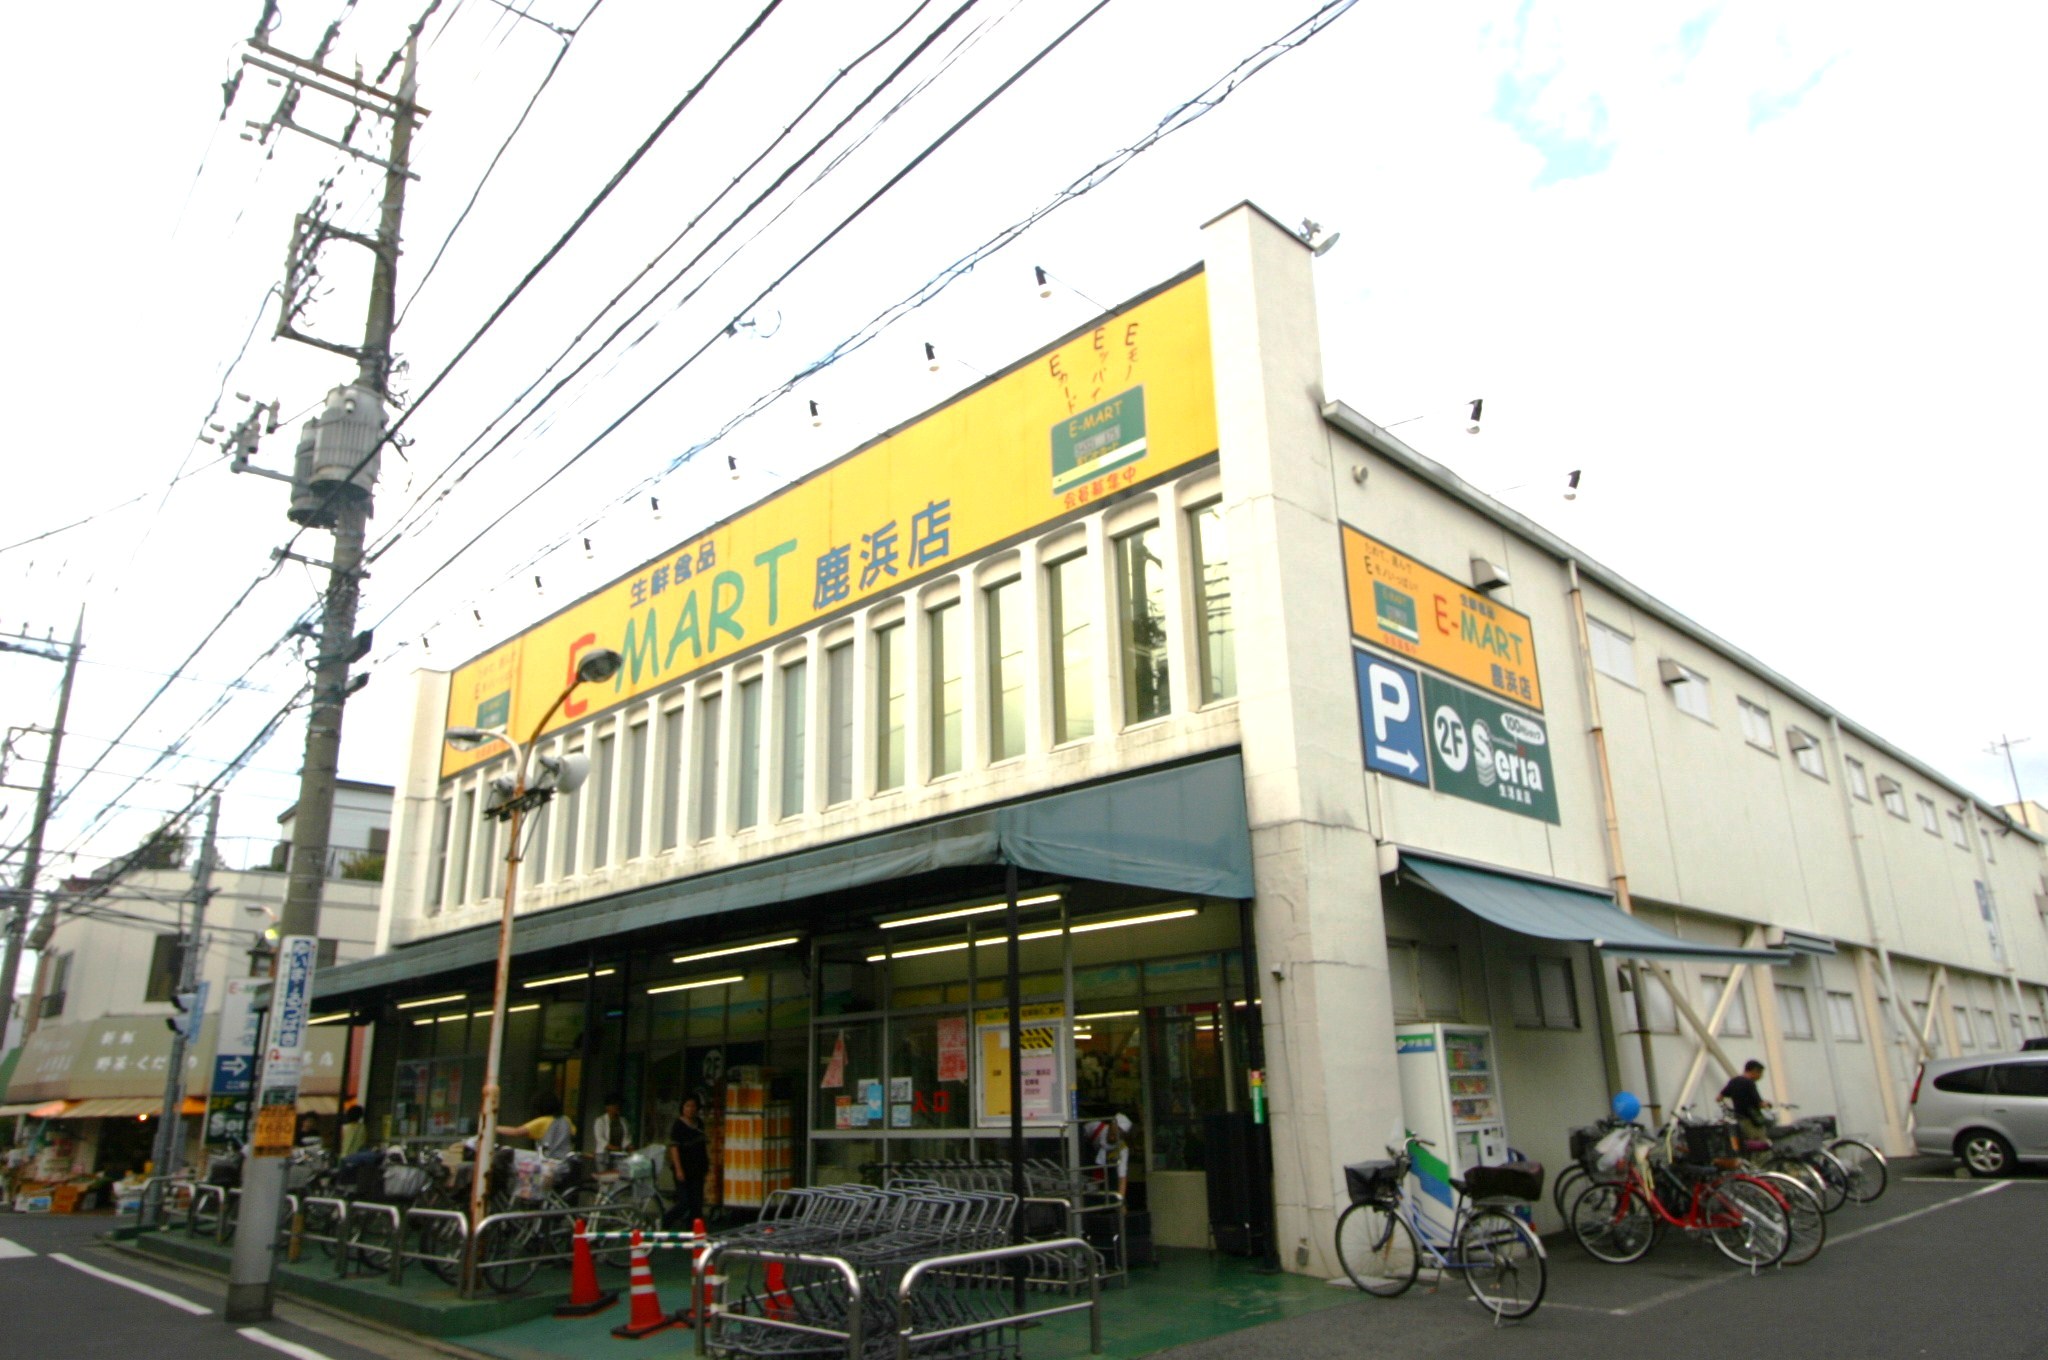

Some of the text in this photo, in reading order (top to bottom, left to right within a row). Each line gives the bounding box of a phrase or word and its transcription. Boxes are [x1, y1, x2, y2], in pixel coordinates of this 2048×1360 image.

[630, 540, 716, 609] 生鮮食品
[813, 498, 953, 611] 鹿浜店
[1433, 593, 1523, 666] E-MART
[1368, 662, 1410, 742] P
[1437, 716, 1464, 759] 2F
[1472, 719, 1544, 792] Seria
[912, 1090, 951, 1114] 入口
